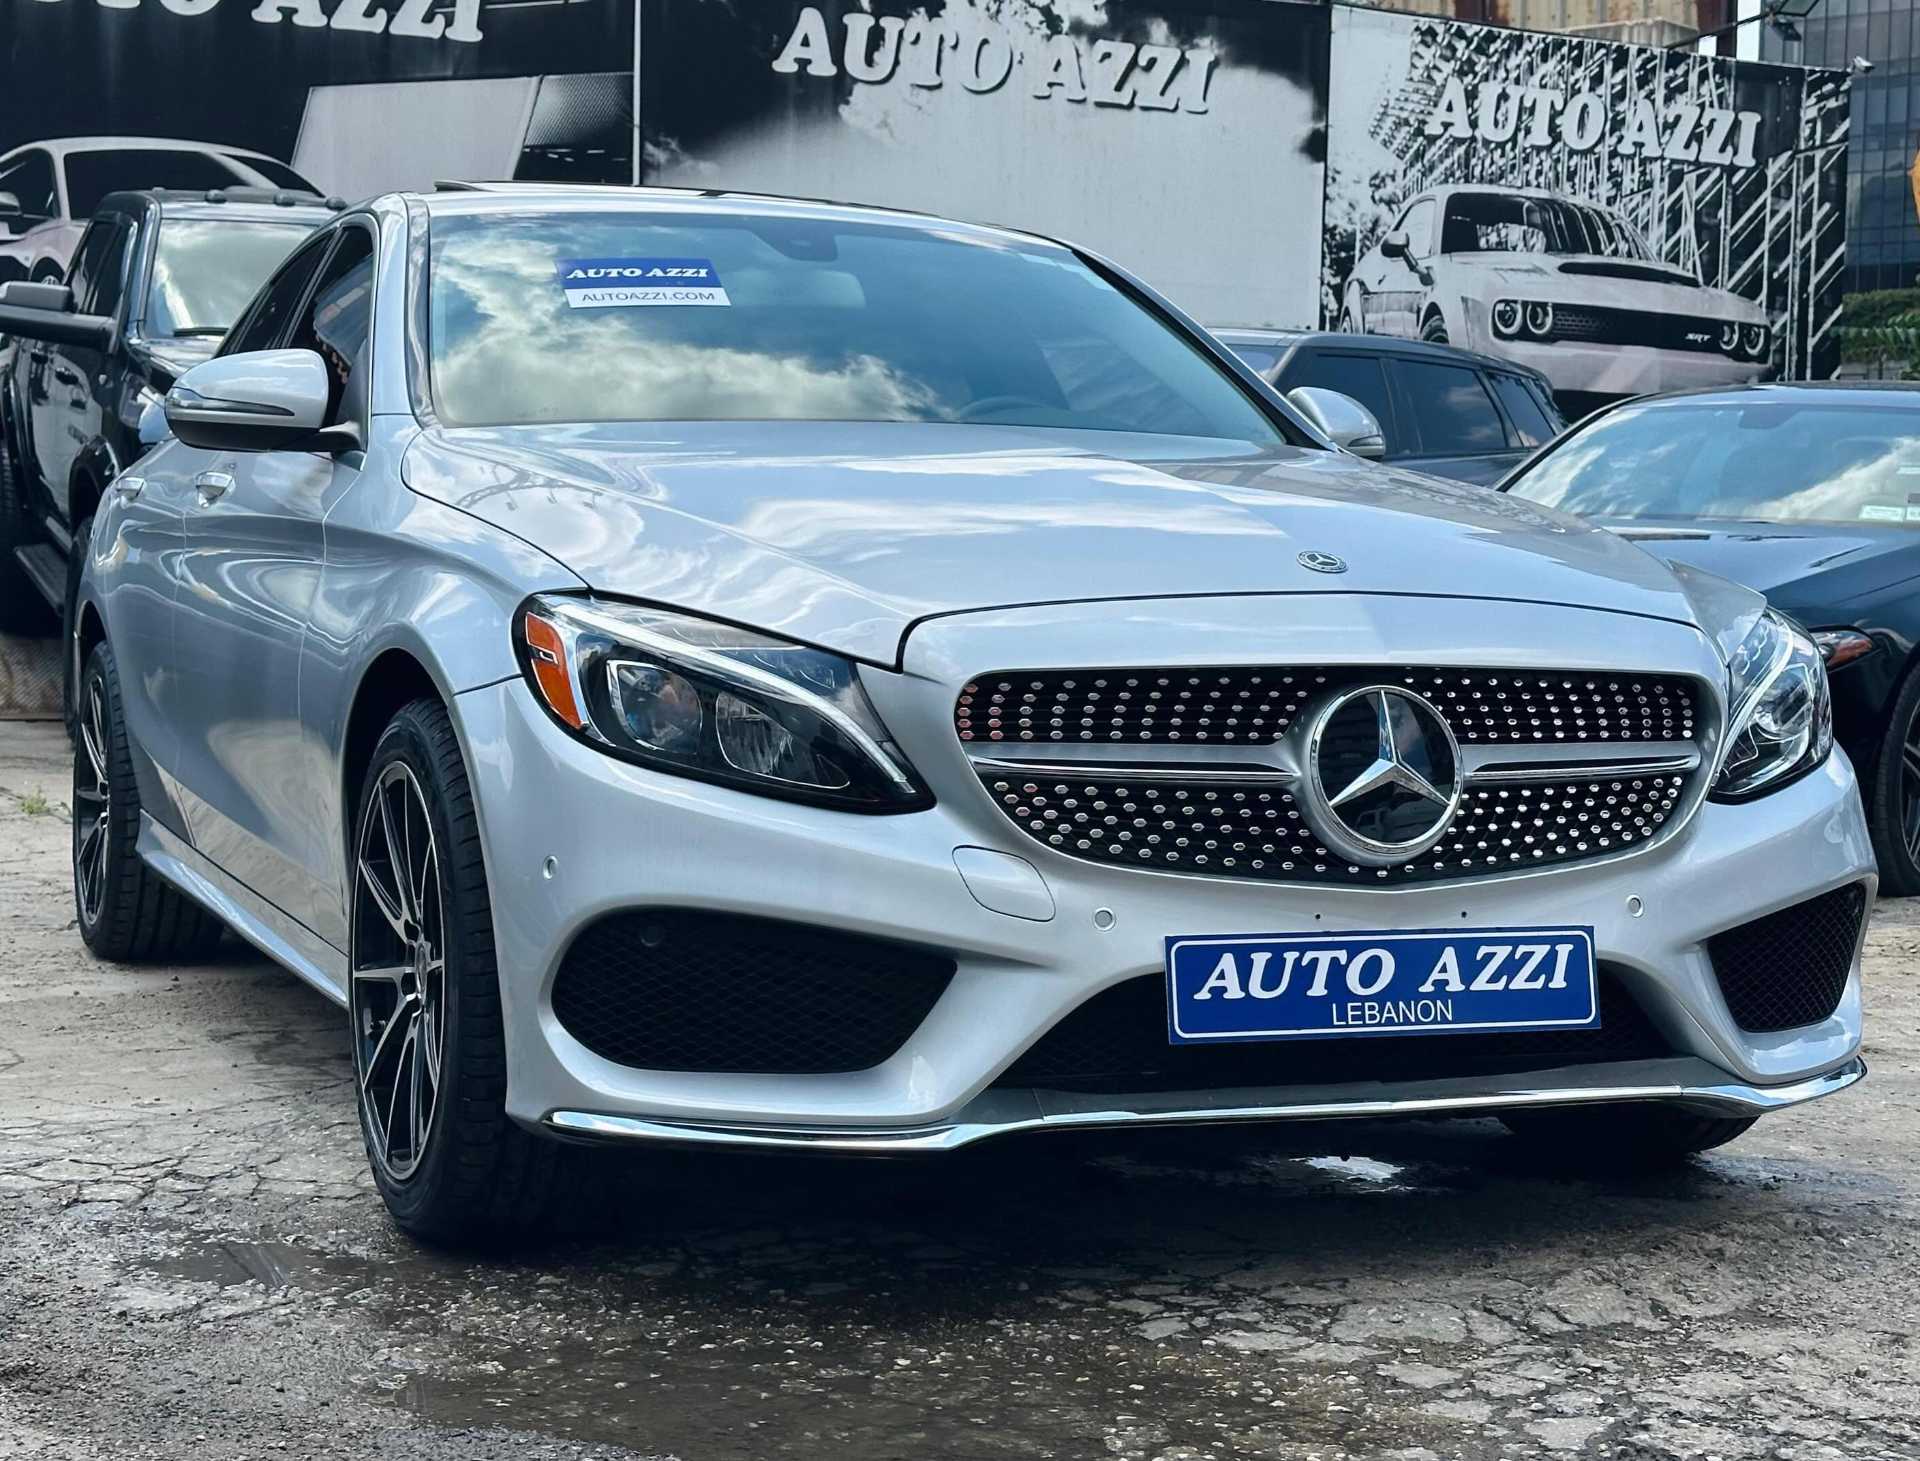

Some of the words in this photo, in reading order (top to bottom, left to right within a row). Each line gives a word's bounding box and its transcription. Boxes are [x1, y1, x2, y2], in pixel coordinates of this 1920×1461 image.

[772, 7, 1013, 93] AUTO
[1031, 35, 1215, 113] AZZI
[1425, 76, 1606, 150] AUTO
[1616, 98, 1761, 168] AZZI
[566, 267, 642, 279] AUTO
[646, 267, 709, 278] AZZI
[582, 291, 715, 301] AUTOAZZI.COM
[1193, 948, 1395, 1000] AUTO
[1418, 943, 1575, 993] AZZI
[1332, 999, 1453, 1026] LEBANON
